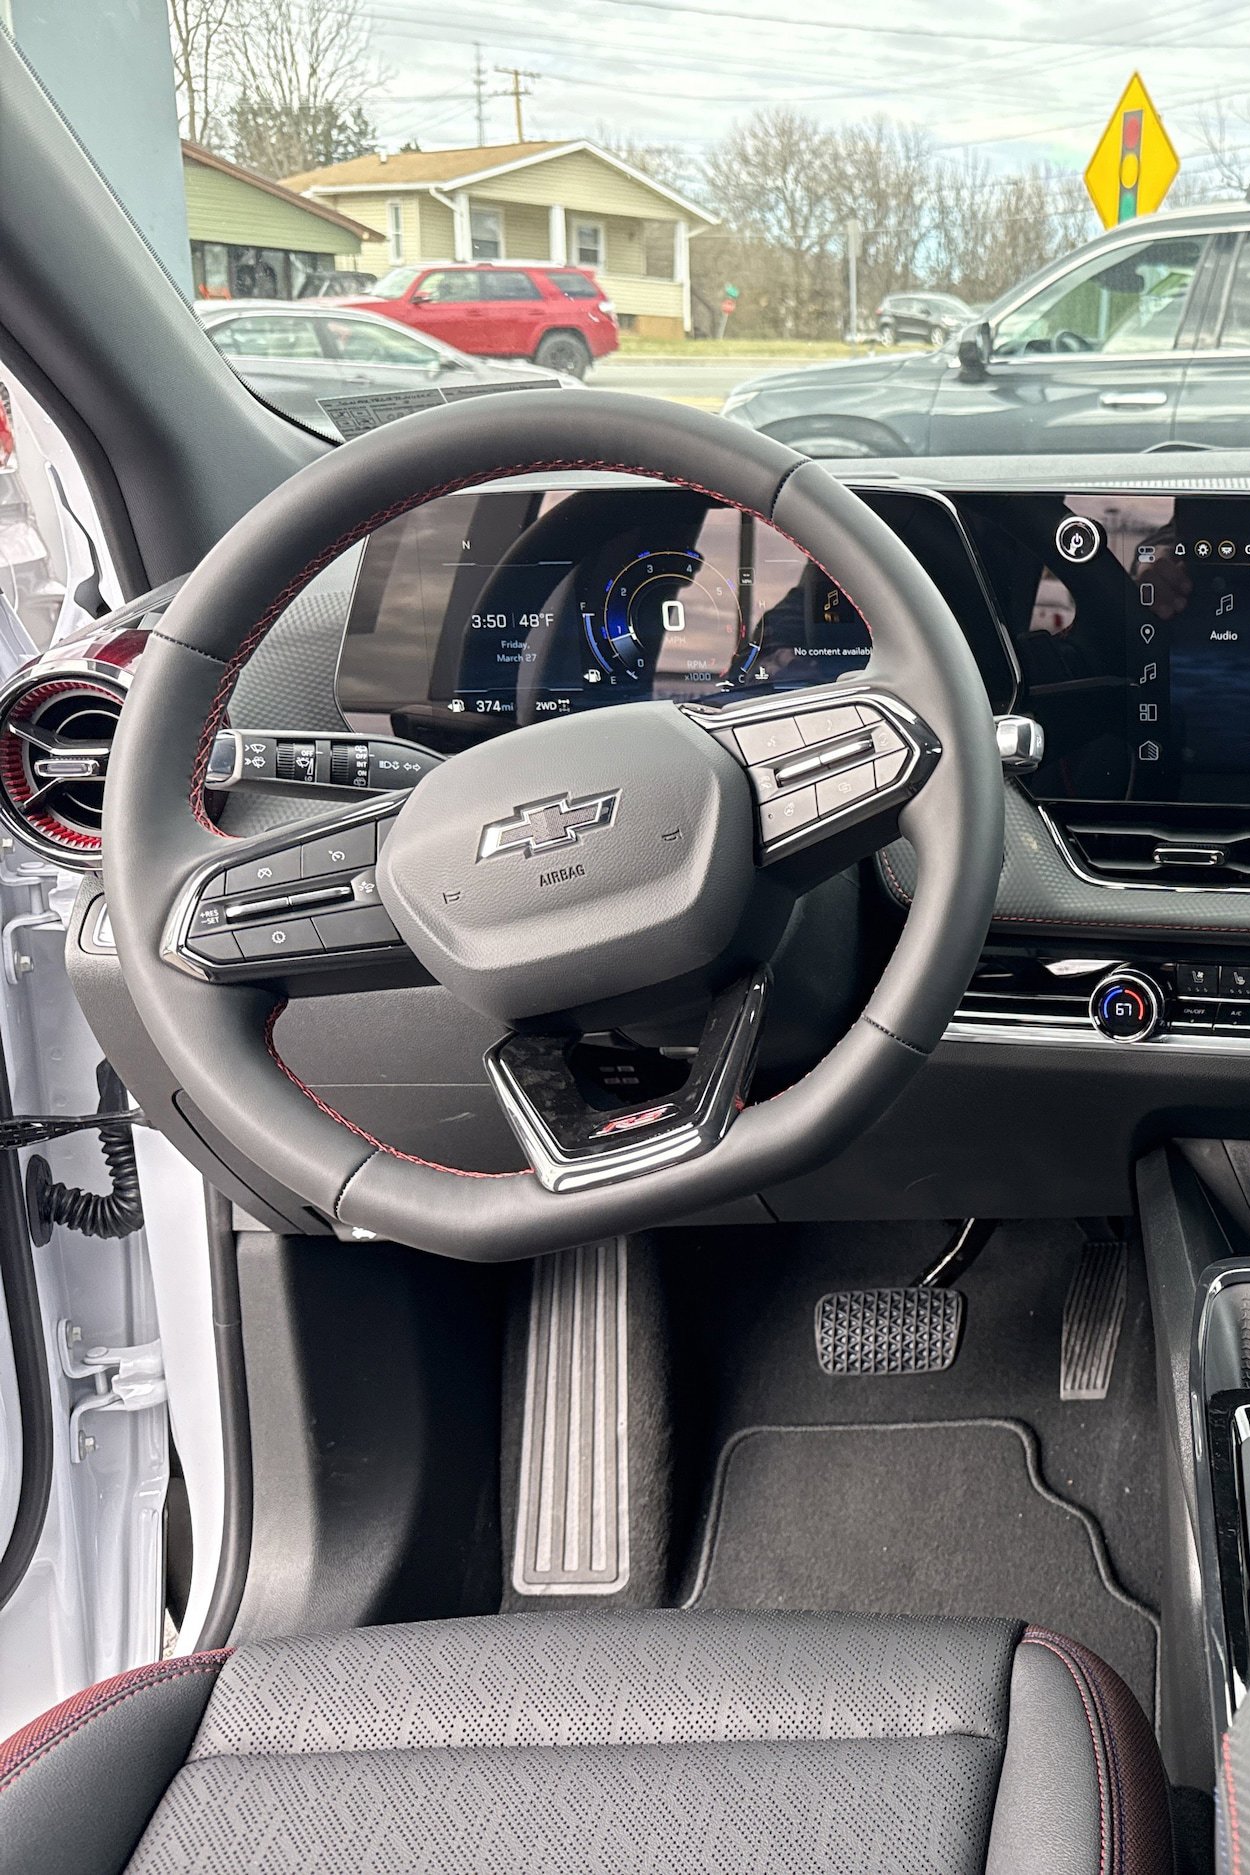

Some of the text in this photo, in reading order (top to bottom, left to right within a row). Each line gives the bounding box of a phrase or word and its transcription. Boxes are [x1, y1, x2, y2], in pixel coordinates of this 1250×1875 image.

[462, 540, 471, 550] N
[647, 564, 654, 574] 3
[686, 564, 693, 573] 4
[620, 587, 628, 597] 2
[716, 587, 723, 596] 5
[580, 602, 586, 611] F
[471, 612, 555, 629] 3:50 48°F
[662, 600, 685, 631] 0
[617, 625, 622, 634] 1
[1210, 630, 1238, 641] Audio
[794, 647, 807, 656] No
[808, 647, 841, 656] content
[496, 652, 537, 663] March 27
[637, 658, 645, 668] 0
[686, 660, 708, 669] RPM
[610, 676, 617, 685] E
[685, 672, 712, 681] x1000
[738, 674, 745, 684] C
[535, 701, 557, 711] 2WD
[300, 749, 314, 757] OFF
[357, 769, 368, 777] ON
[539, 864, 586, 887] AIRBAG
[200, 909, 220, 918] +RES
[1115, 1002, 1132, 1016] 67
